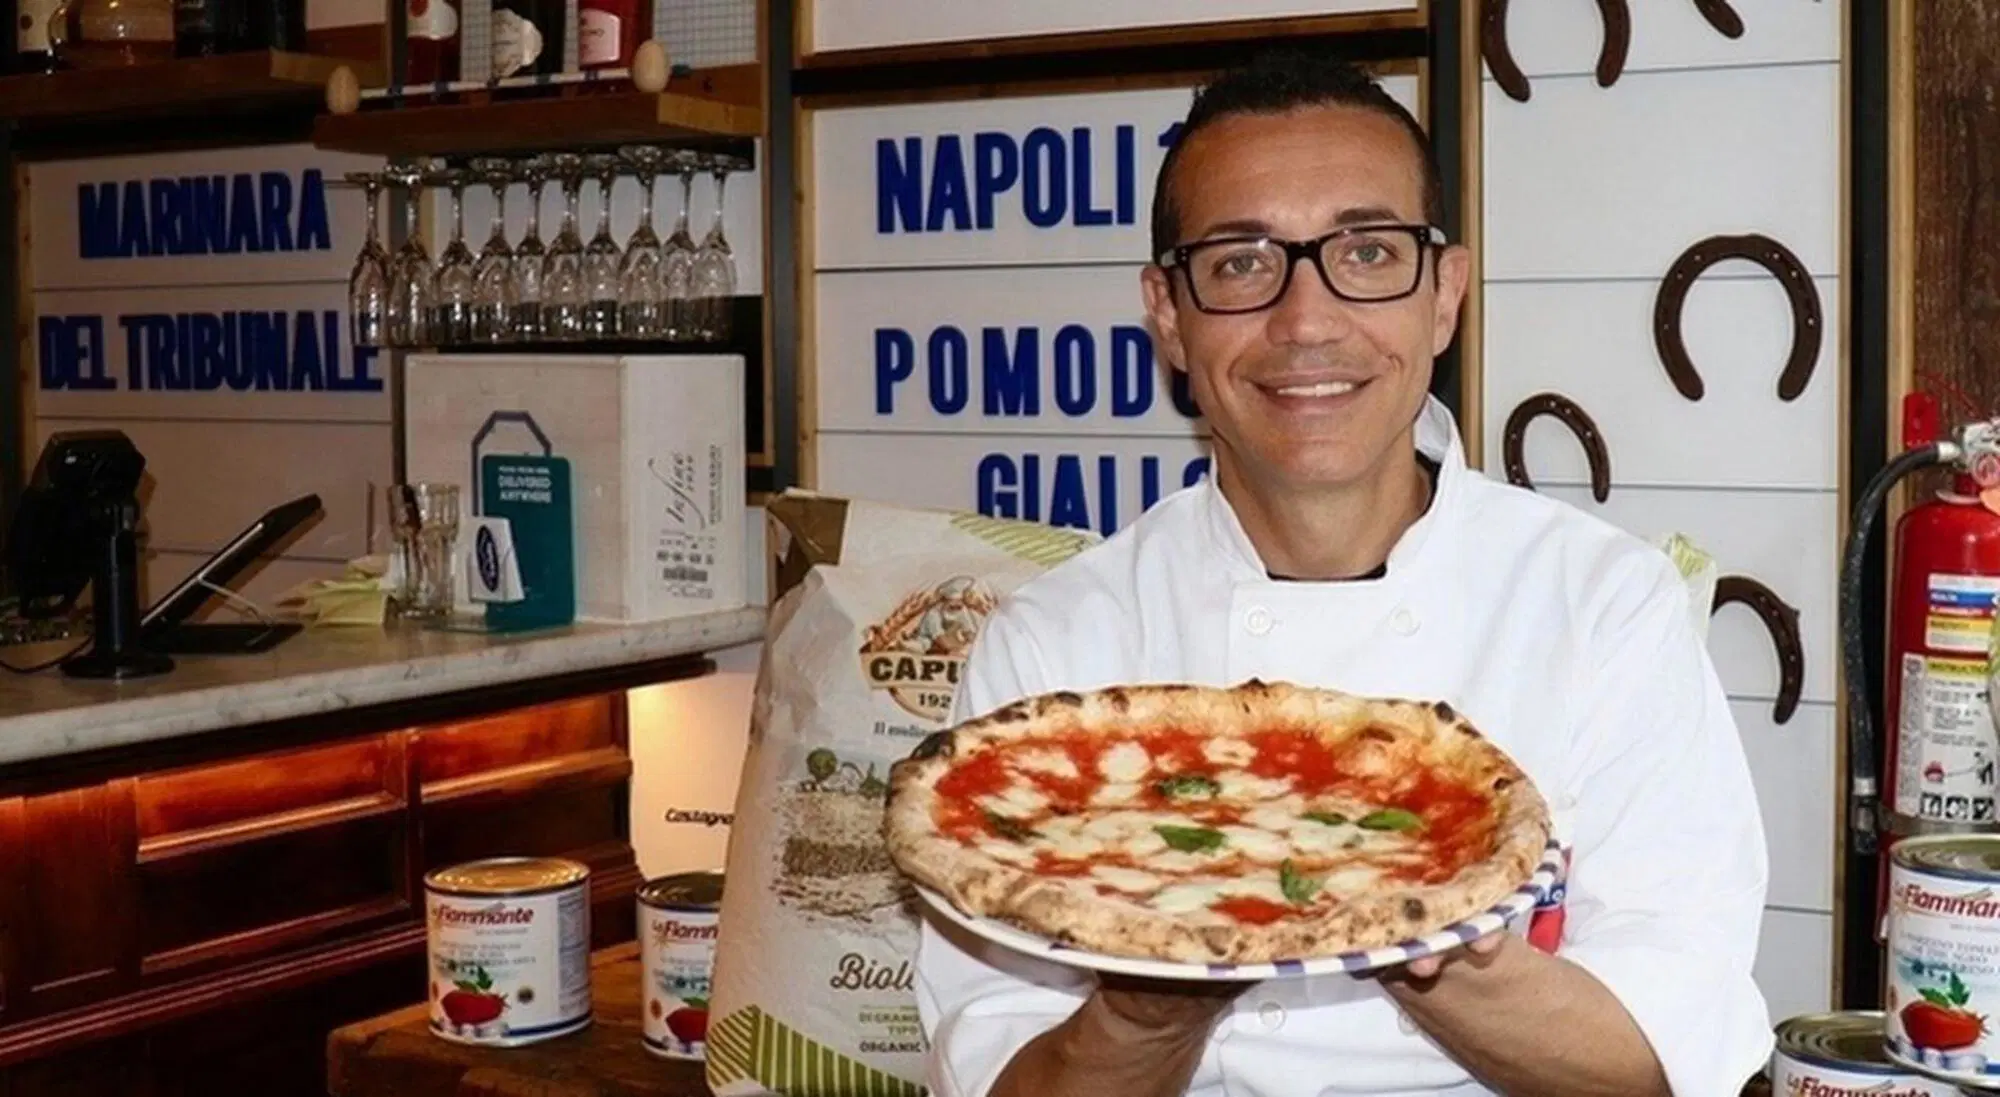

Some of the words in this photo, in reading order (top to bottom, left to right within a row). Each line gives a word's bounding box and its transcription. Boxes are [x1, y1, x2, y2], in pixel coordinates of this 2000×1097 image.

[78, 169, 331, 258] MARINARA
[876, 125, 1136, 234] NAPOLI
[38, 316, 118, 391] DEL
[119, 310, 384, 391] TRIBUNALE
[438, 903, 535, 925] Fiammante
